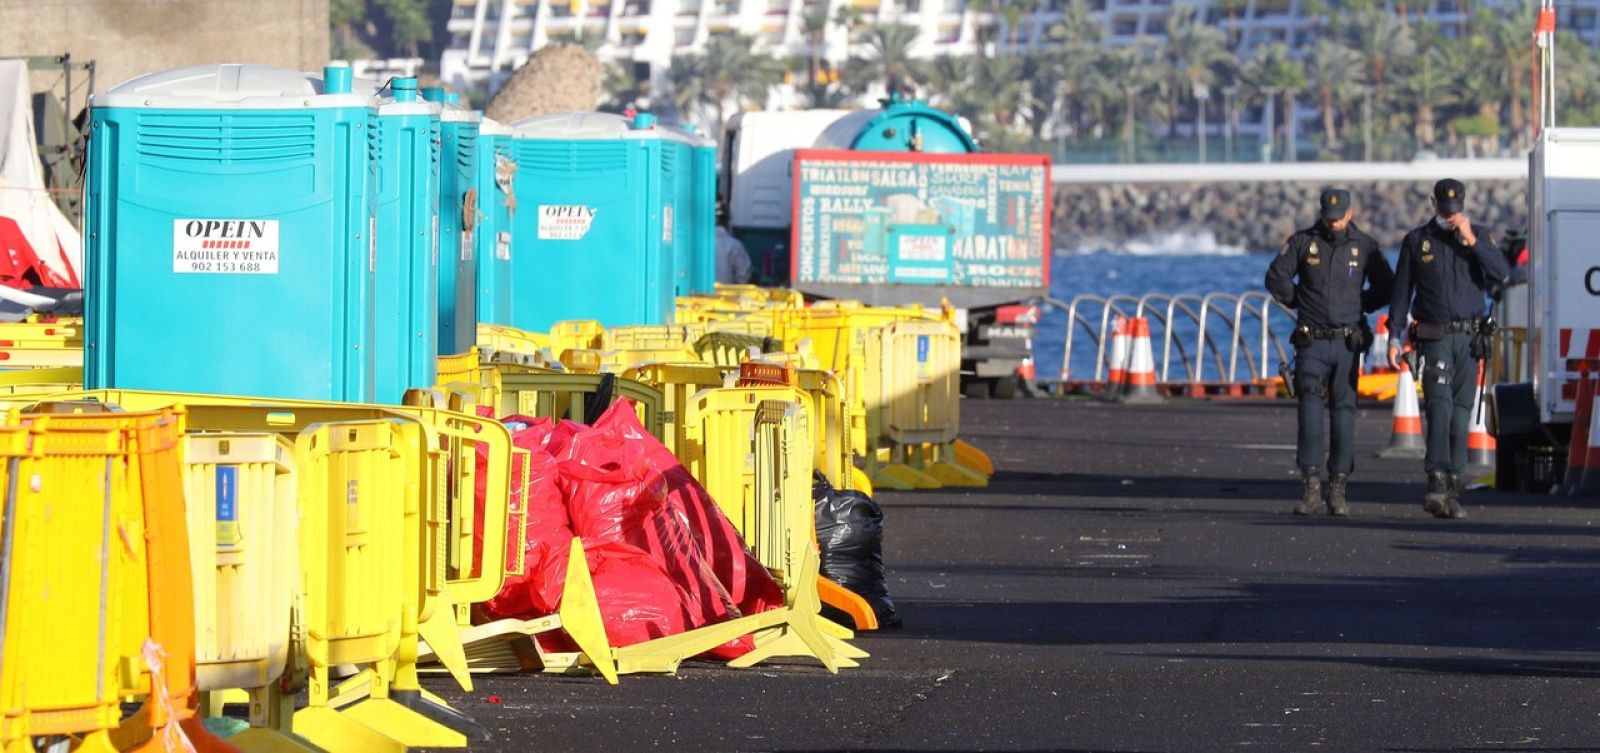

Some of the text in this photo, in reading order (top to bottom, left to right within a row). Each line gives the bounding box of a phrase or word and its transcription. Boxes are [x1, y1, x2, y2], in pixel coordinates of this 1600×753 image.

[871, 169, 917, 187] SALSA
[820, 198, 874, 213] RALLY
[185, 220, 266, 238] OPEIN
[176, 250, 276, 261] ALQUILER Y VENTA
[191, 261, 261, 272] 902 153 688
[987, 327, 1032, 338] MAN
